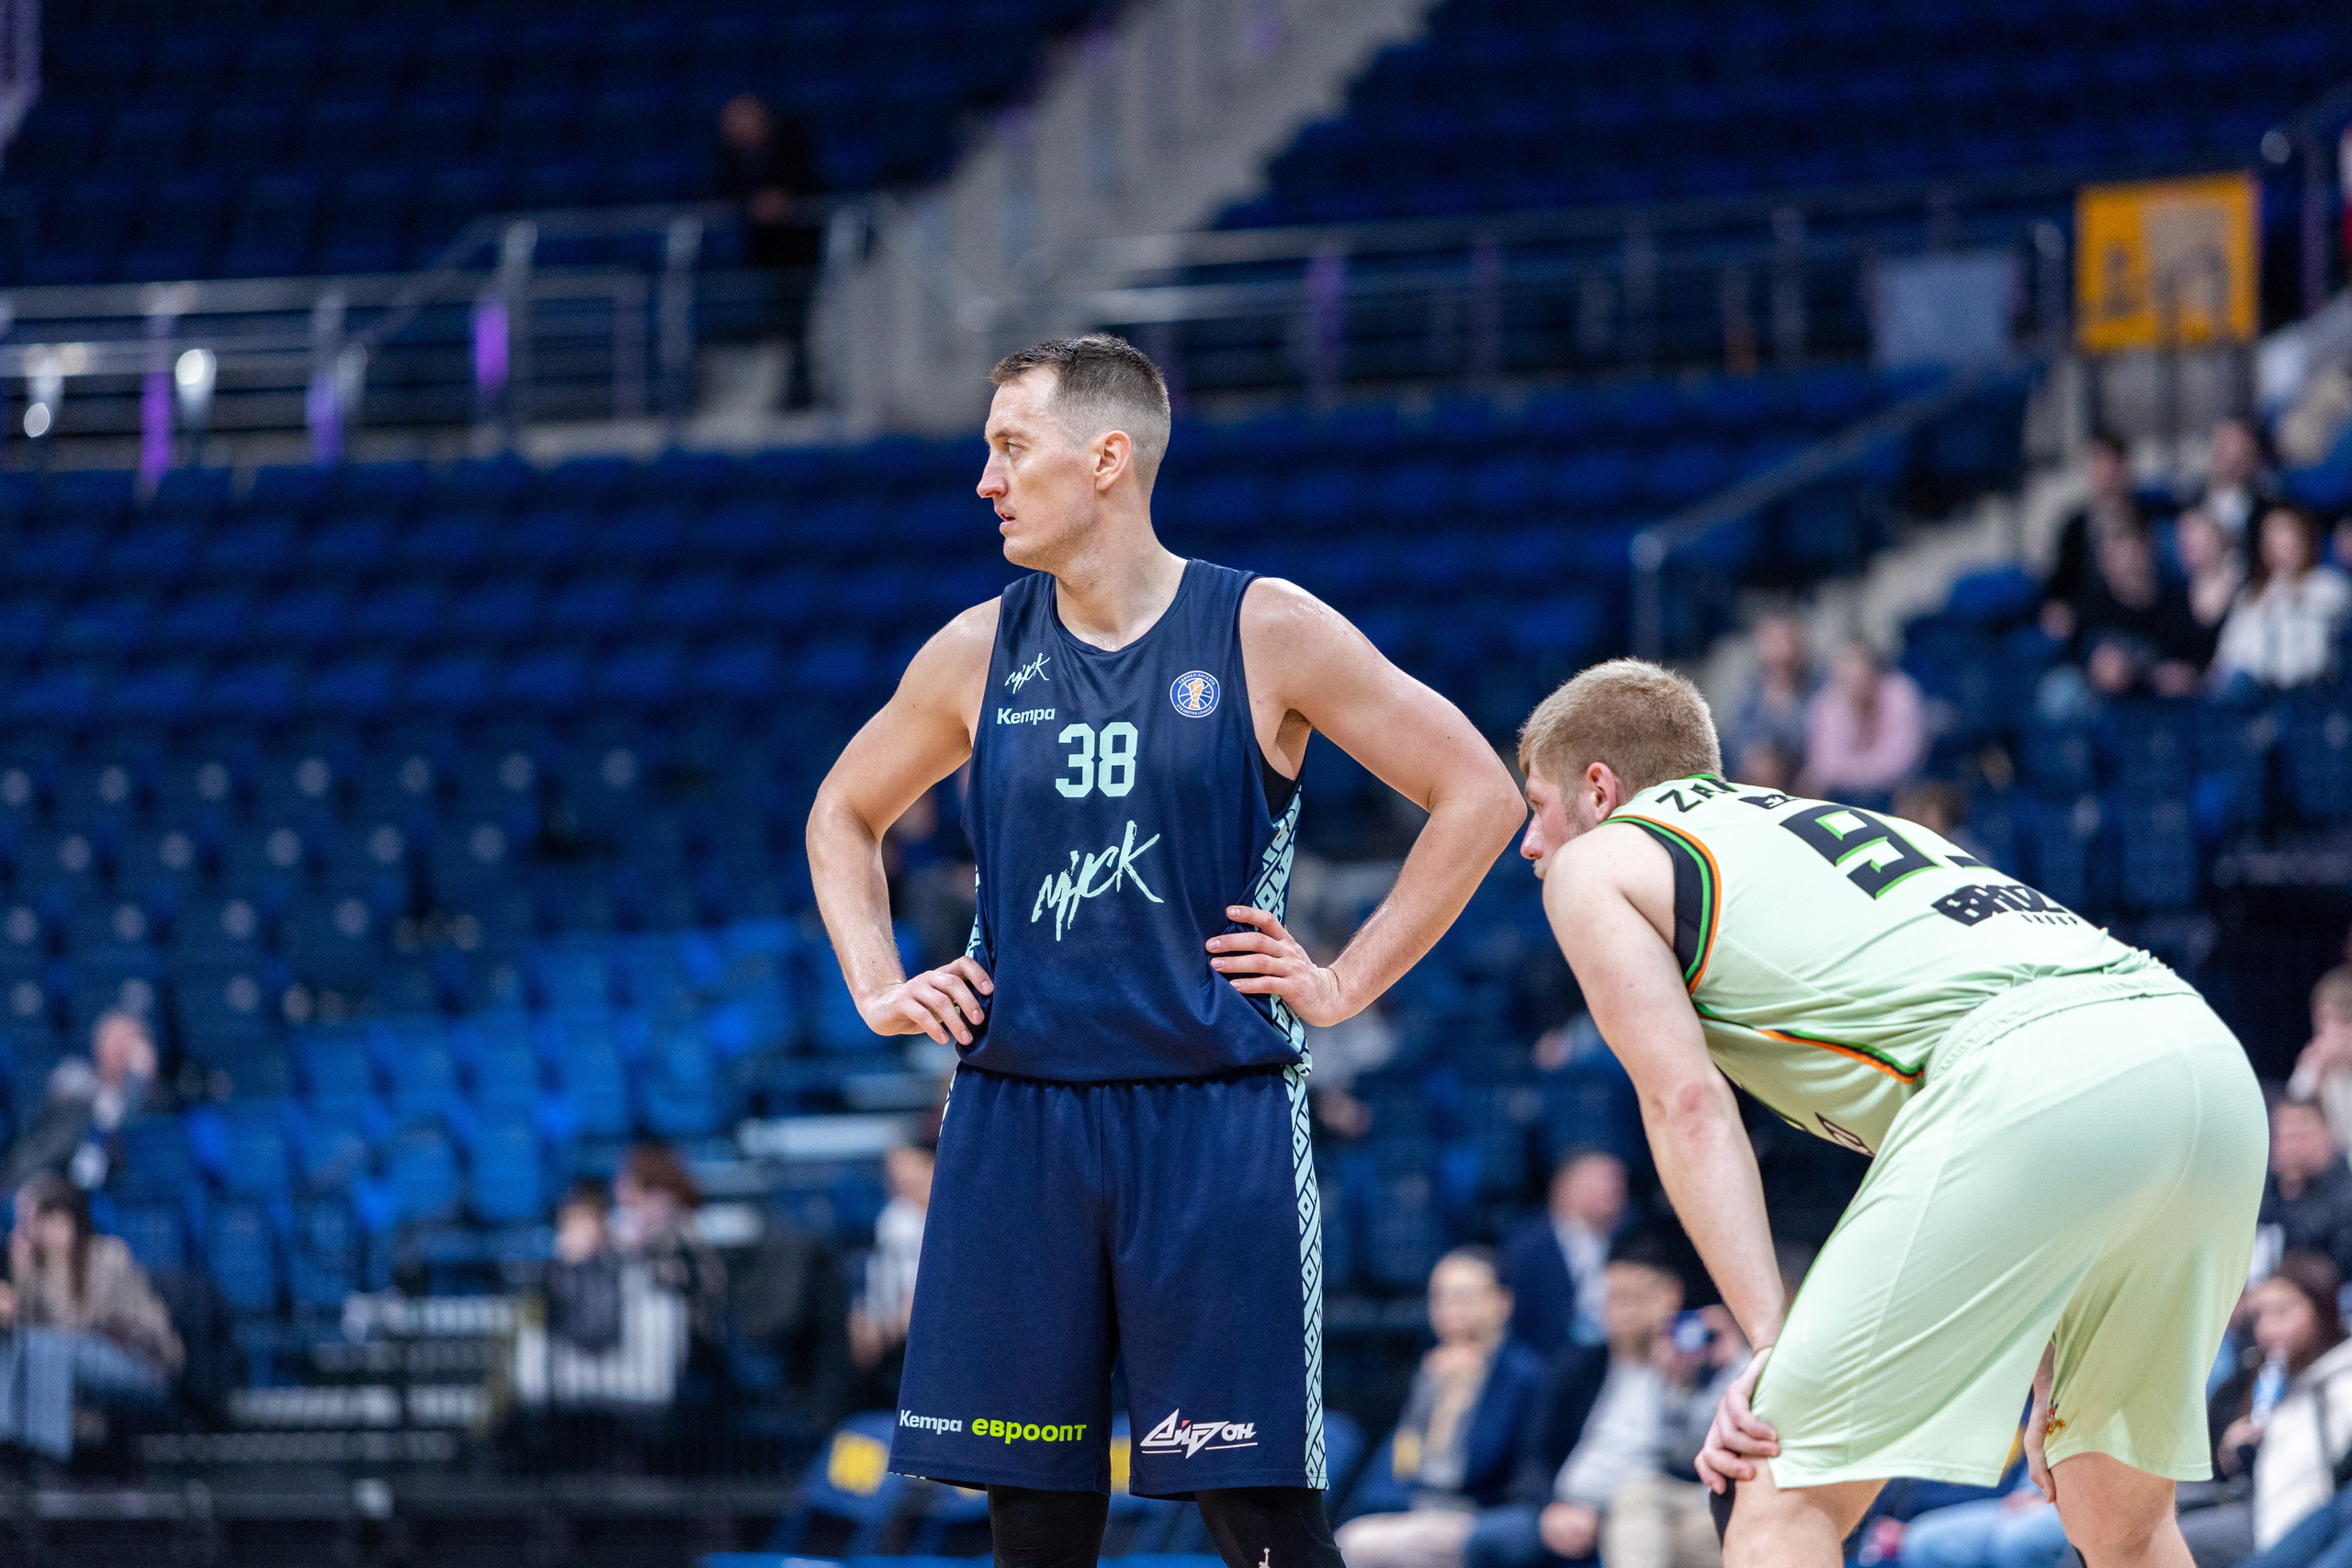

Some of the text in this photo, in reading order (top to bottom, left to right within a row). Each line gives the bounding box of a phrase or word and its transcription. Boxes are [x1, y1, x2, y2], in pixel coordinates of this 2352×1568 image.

[997, 707, 1056, 726] Kempa
[1056, 721, 1138, 797] 38
[1779, 803, 1996, 900] 9
[899, 1409, 962, 1435] Kempa
[971, 1417, 1087, 1445] евроопт
